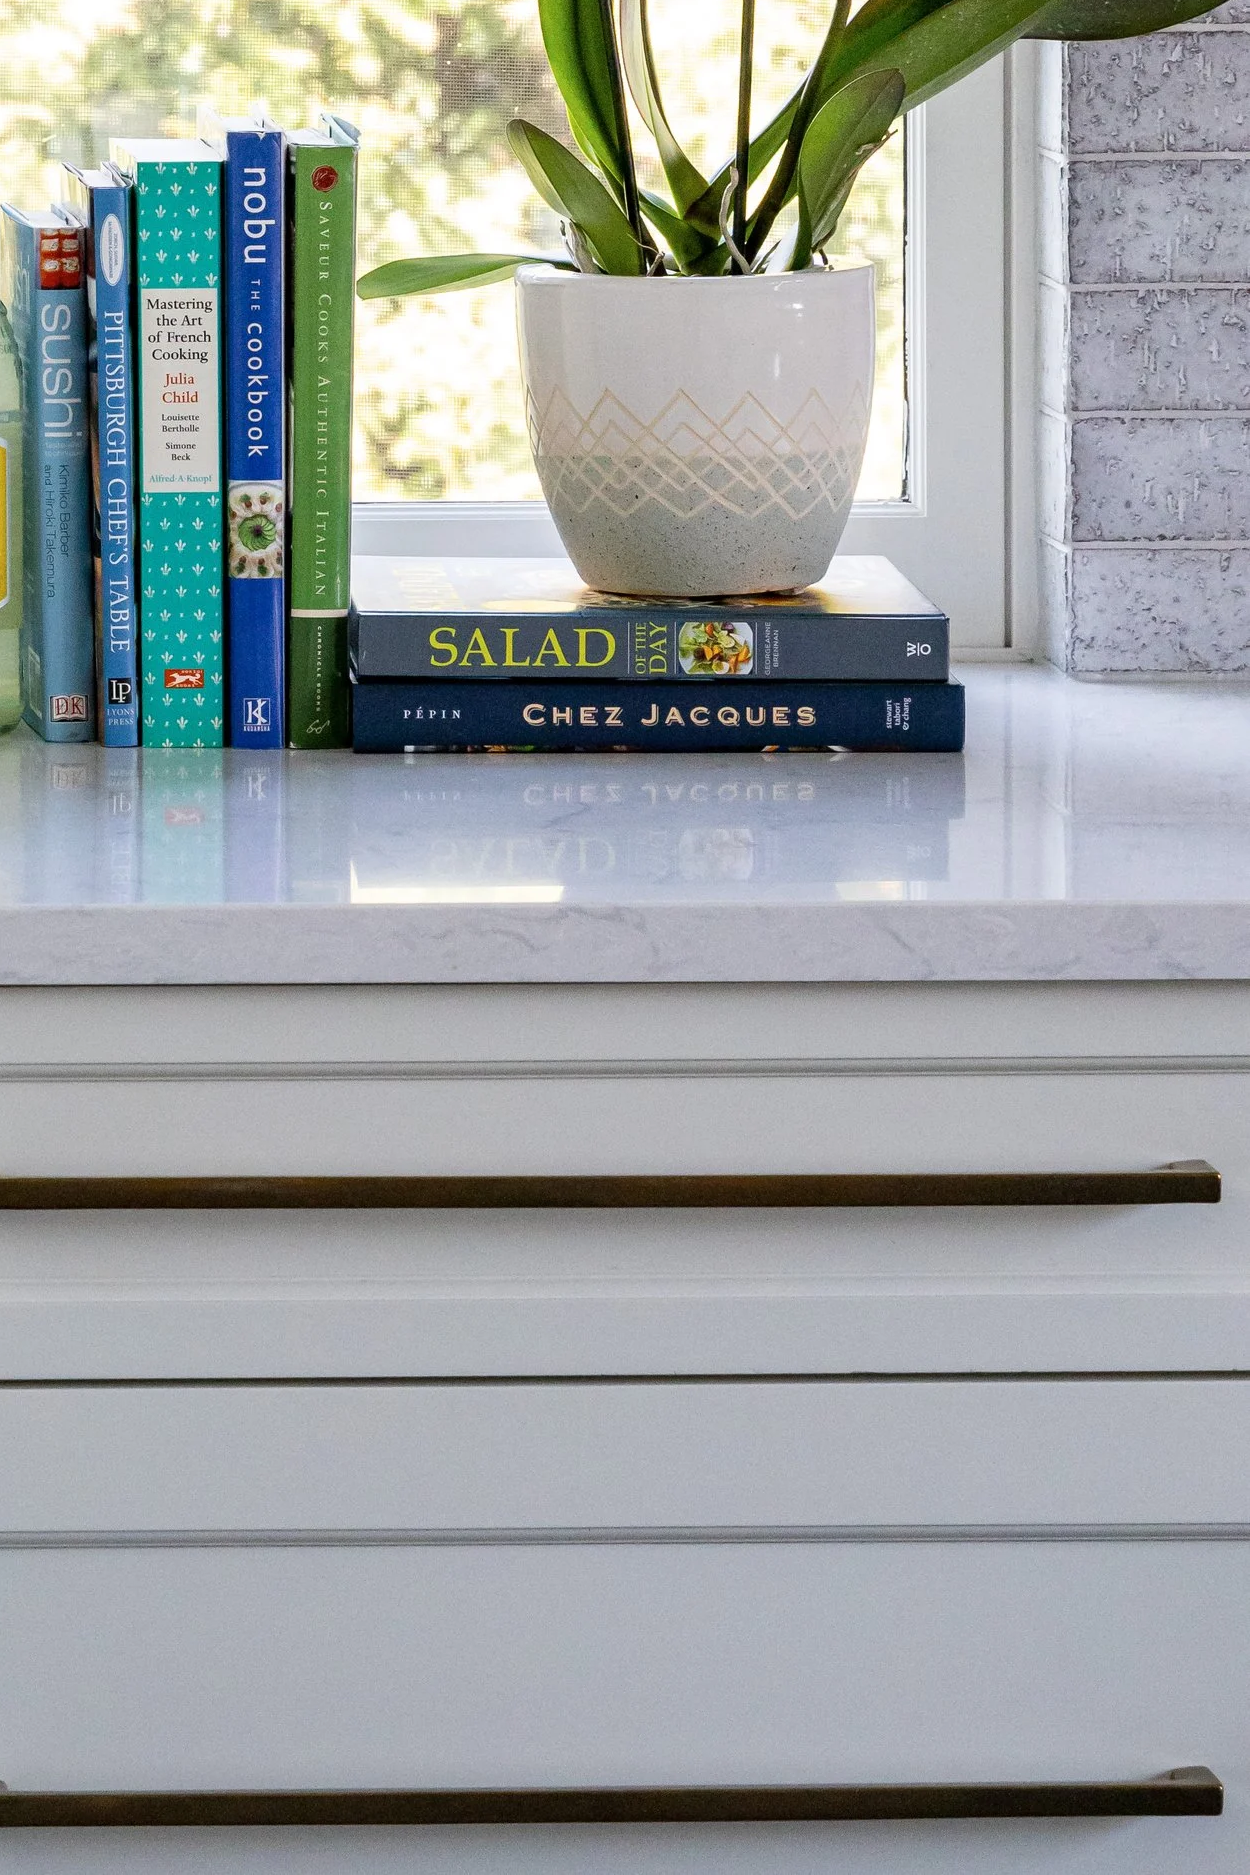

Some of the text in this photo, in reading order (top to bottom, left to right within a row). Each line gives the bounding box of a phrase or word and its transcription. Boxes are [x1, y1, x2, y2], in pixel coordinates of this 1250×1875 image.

[147, 298, 213, 313] Mastering
[243, 167, 276, 458] nobu THE cookbook
[156, 314, 203, 326] the Art
[148, 330, 211, 343] of French
[152, 348, 209, 364] Cooking
[40, 303, 83, 438] sushi
[164, 372, 195, 387] Julia
[162, 390, 199, 404] Child
[315, 201, 333, 595] SAVEUR COOKS AUTHENTIC ITALIAN
[161, 413, 200, 421] Louisette
[161, 424, 200, 433] Bertholle
[165, 442, 197, 450] Simone
[171, 453, 191, 461] Beck
[104, 311, 131, 654] PITTSBURGH CHEF'S TABLE
[59, 464, 70, 558] Kimiko Barber
[44, 465, 57, 598] and Hiroki Takemura
[428, 627, 616, 668] SALAD
[634, 622, 647, 675] OF THE
[649, 621, 667, 674] DAY
[54, 696, 84, 716] DK
[107, 708, 135, 716] LYONS
[403, 706, 462, 719] PÉPIN
[522, 703, 817, 727] CHEZ JACQUES
[893, 702, 901, 726] tabori
[901, 698, 912, 721] chang
